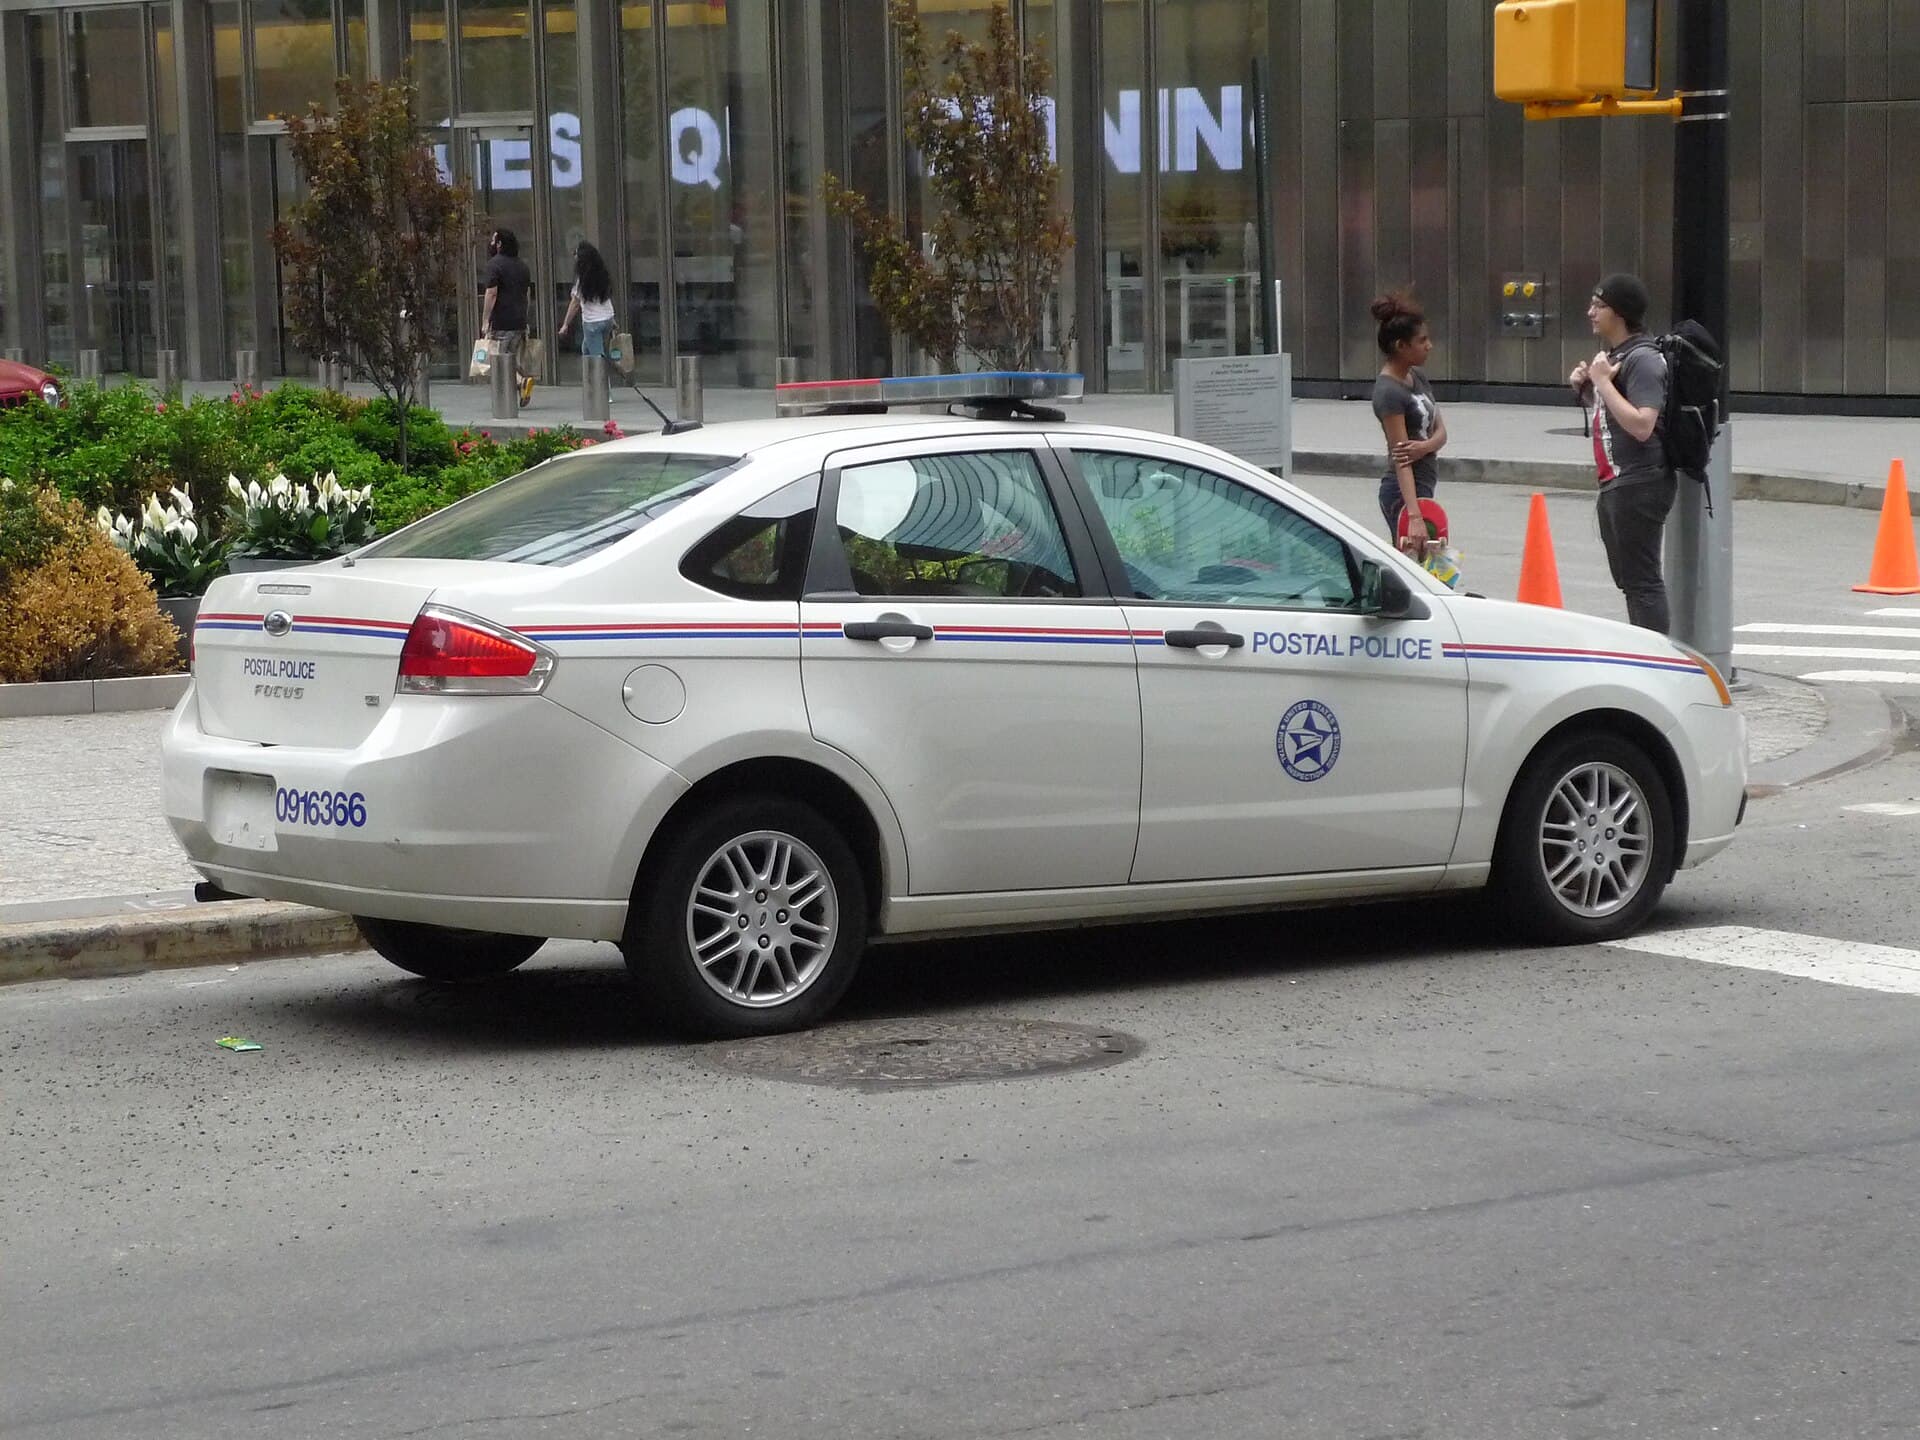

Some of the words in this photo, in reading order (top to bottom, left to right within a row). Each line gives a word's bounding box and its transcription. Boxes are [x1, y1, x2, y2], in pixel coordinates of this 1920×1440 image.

[1252, 631, 1344, 656] POSTAL
[1349, 636, 1432, 660] POLICE
[243, 658, 278, 677] POSTAL
[279, 660, 315, 679] POLICE
[255, 684, 304, 700] FOCUS
[1283, 702, 1307, 723] UNITED
[276, 787, 367, 828] 0916366
